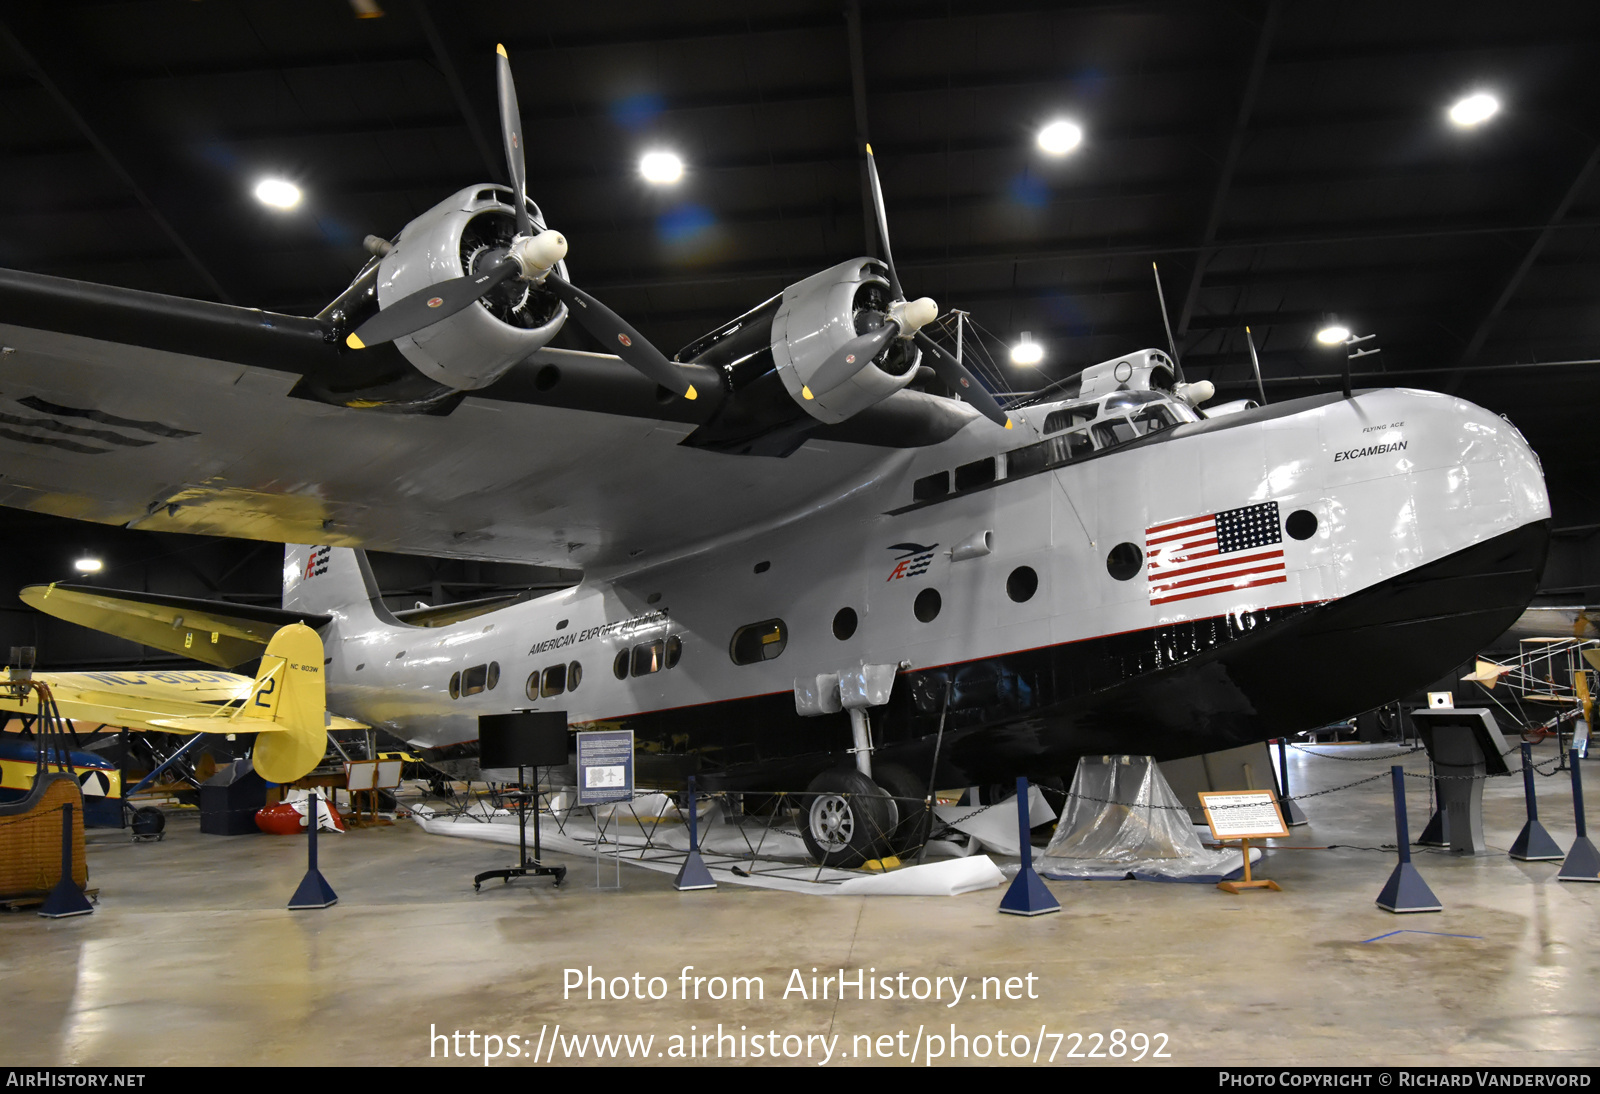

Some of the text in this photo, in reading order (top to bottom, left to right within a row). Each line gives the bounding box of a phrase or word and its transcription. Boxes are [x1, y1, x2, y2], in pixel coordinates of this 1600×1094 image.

[1362, 424, 1387, 433] FLYING
[1334, 440, 1408, 462] EXCAMBIAN
[528, 607, 670, 656] AMERICAN EXPORT AIRLINES
[301, 664, 319, 673] 803W
[255, 676, 275, 708] 2
